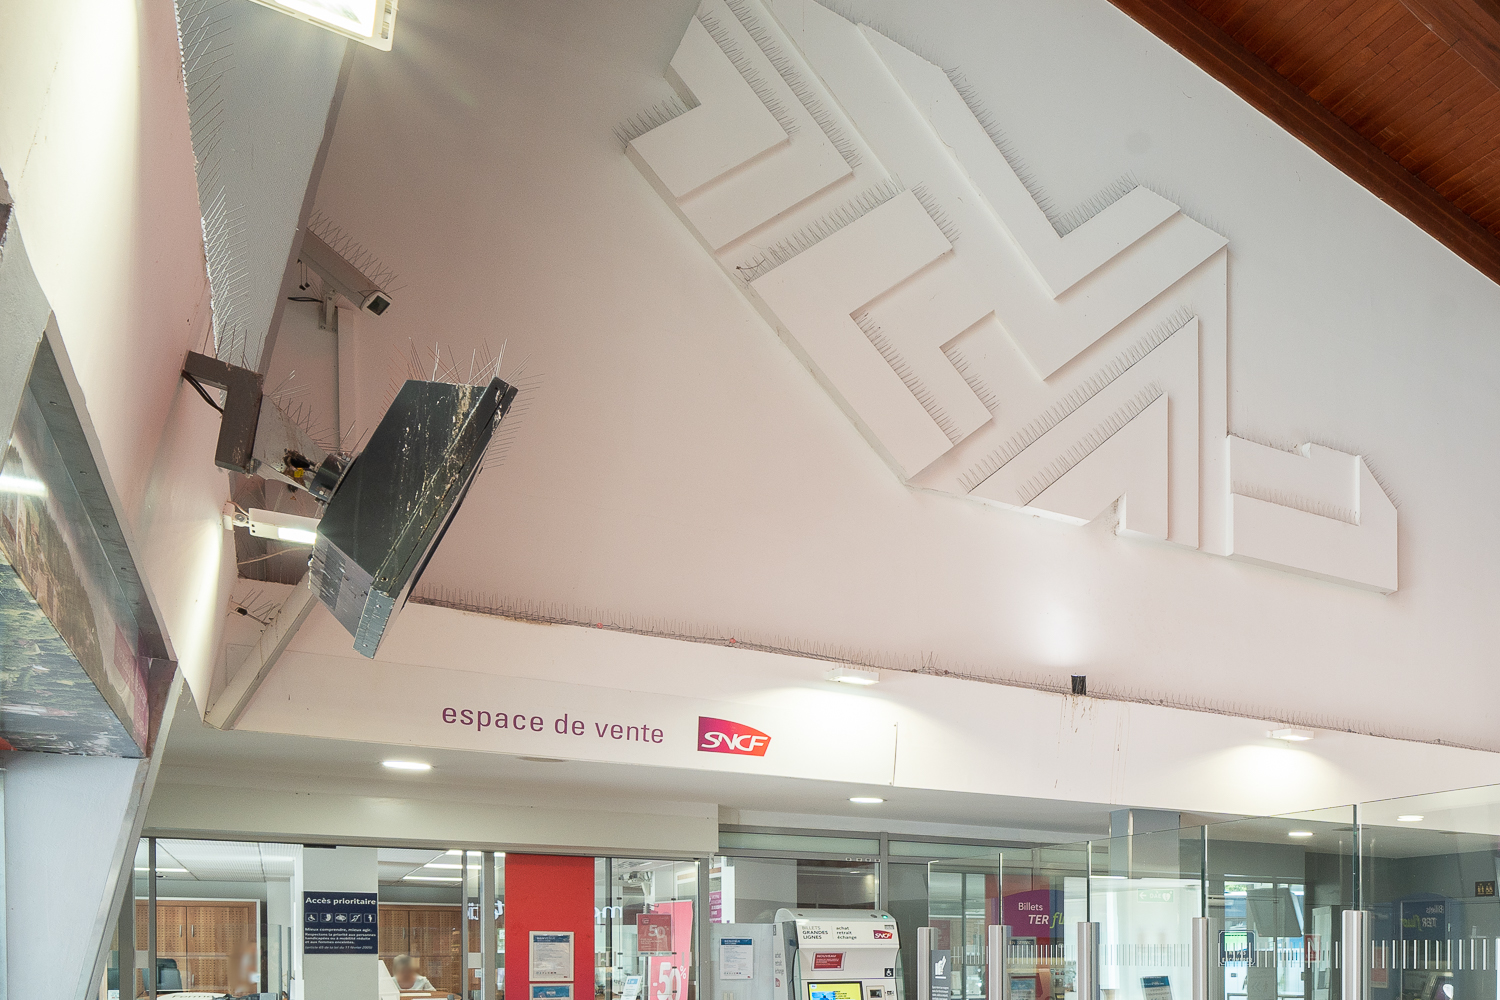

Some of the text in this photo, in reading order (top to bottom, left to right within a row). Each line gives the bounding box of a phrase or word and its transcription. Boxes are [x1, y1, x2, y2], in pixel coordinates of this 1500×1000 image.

[442, 707, 665, 744] espace de vente
[701, 732, 768, 752] SNCF
[1018, 902, 1044, 911] Billets
[1028, 914, 1050, 924] TER
